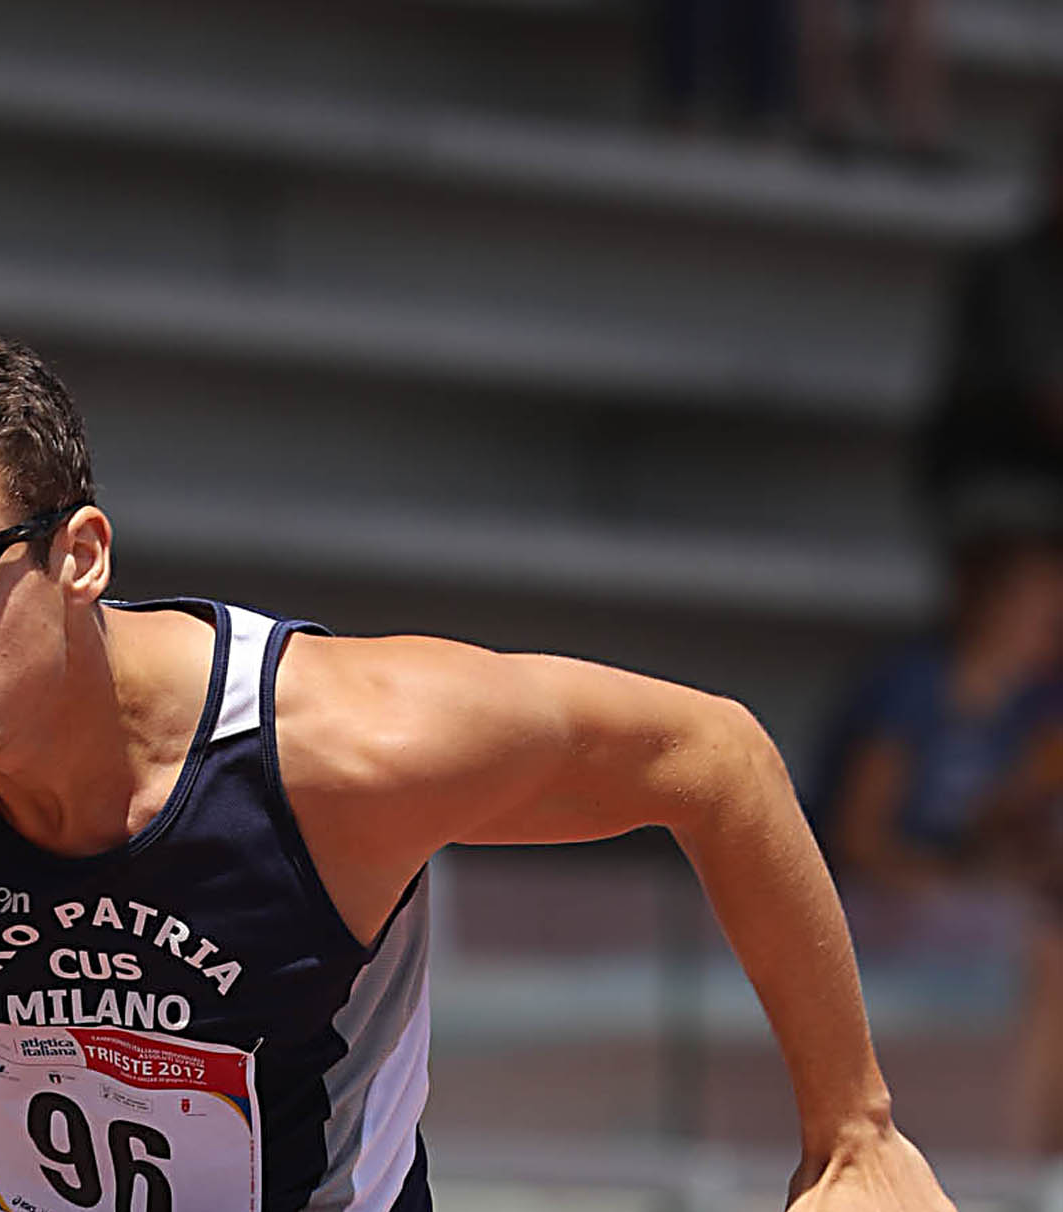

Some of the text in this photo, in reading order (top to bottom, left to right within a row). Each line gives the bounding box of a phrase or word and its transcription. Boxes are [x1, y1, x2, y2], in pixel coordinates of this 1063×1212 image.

[54, 897, 243, 996] PATRIA
[49, 948, 143, 980] CUS
[7, 988, 191, 1031] MILANO
[20, 1036, 75, 1048] atletica
[22, 1045, 77, 1057] italiana
[84, 1044, 154, 1076] TRIESTE
[157, 1061, 205, 1080] 2017
